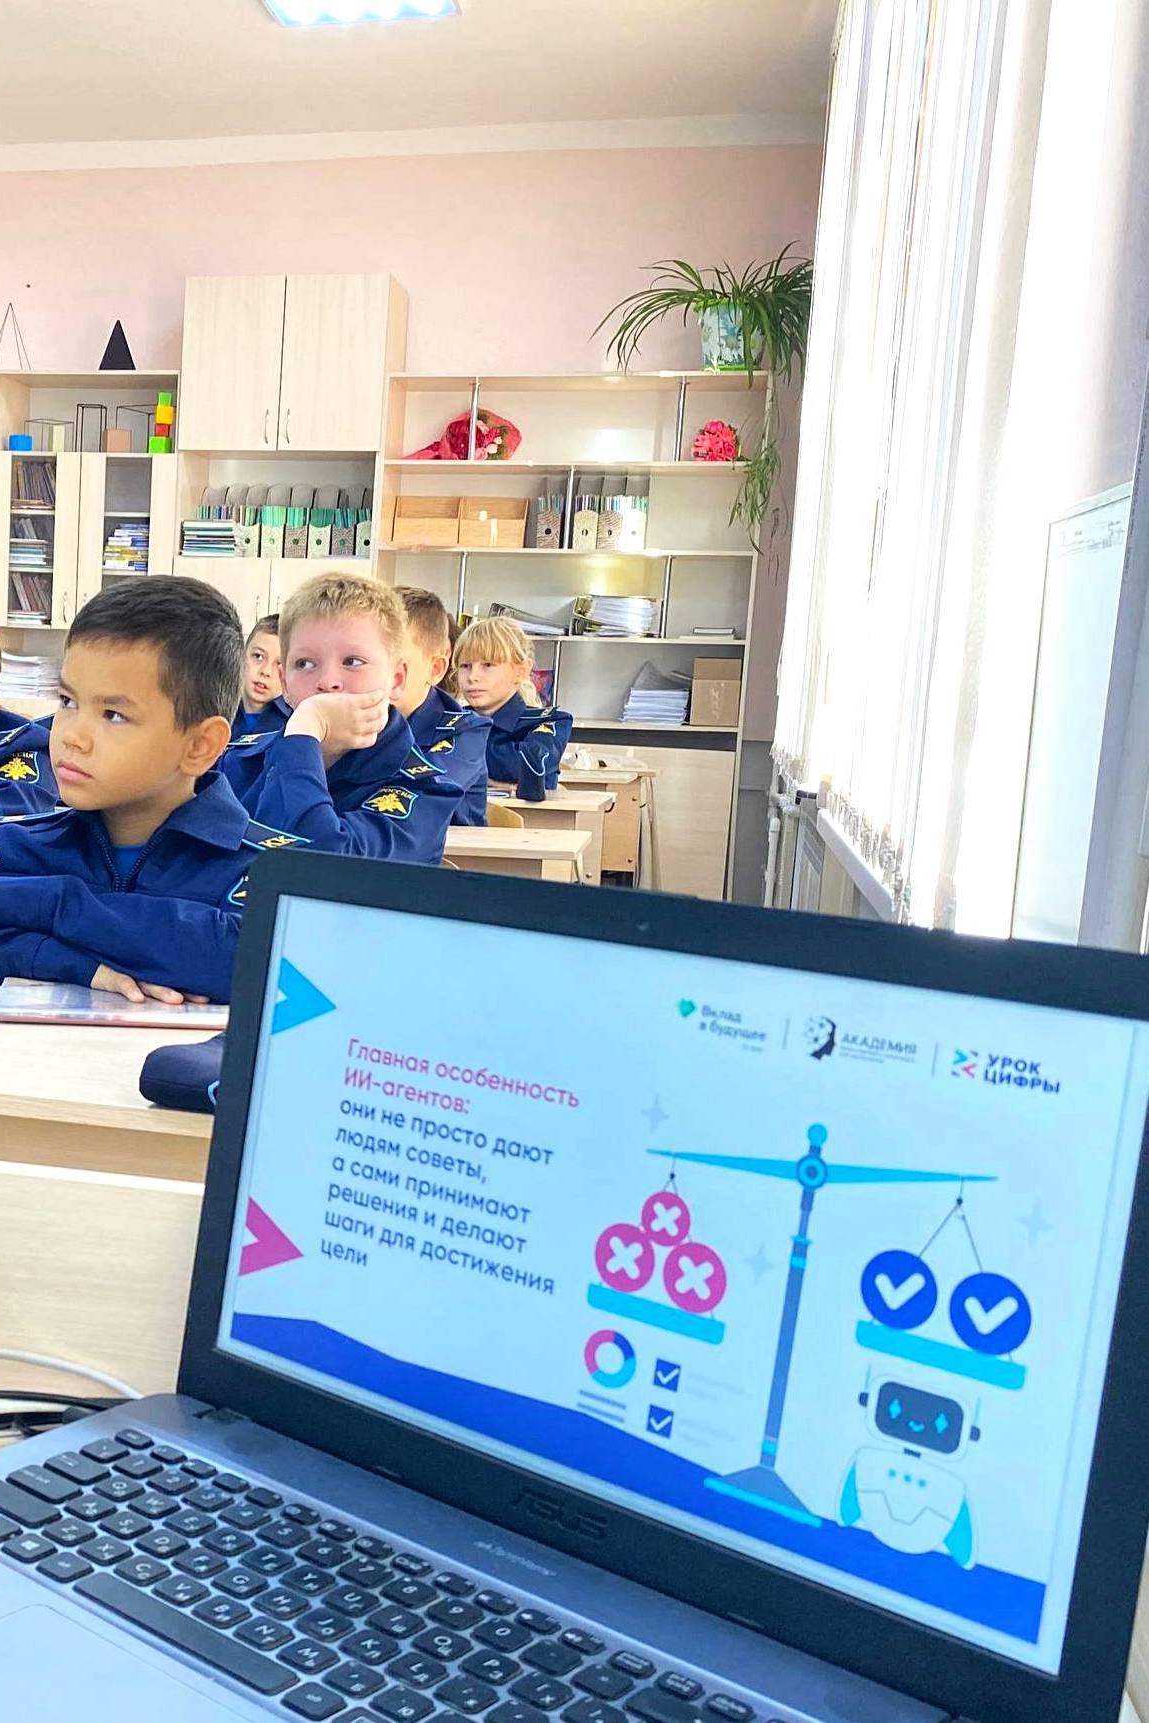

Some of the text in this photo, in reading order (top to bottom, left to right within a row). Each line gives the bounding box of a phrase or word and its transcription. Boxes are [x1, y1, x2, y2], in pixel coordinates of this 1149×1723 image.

[841, 1033, 917, 1054] АКАДЕМИЯ
[987, 1053, 1041, 1075] УРОК
[343, 1066, 471, 1115] ИИ-агентов:
[347, 1038, 580, 1108] Главная особенность
[984, 1069, 1060, 1094] ЦИФРЫ
[335, 1126, 487, 1184] людям советы,
[339, 1099, 555, 1166] они не просто дают
[327, 1181, 527, 1254] решения и делают
[332, 1156, 532, 1224] а сами принимают
[321, 1238, 368, 1267] цели
[324, 1210, 556, 1295] шаги для достижения
